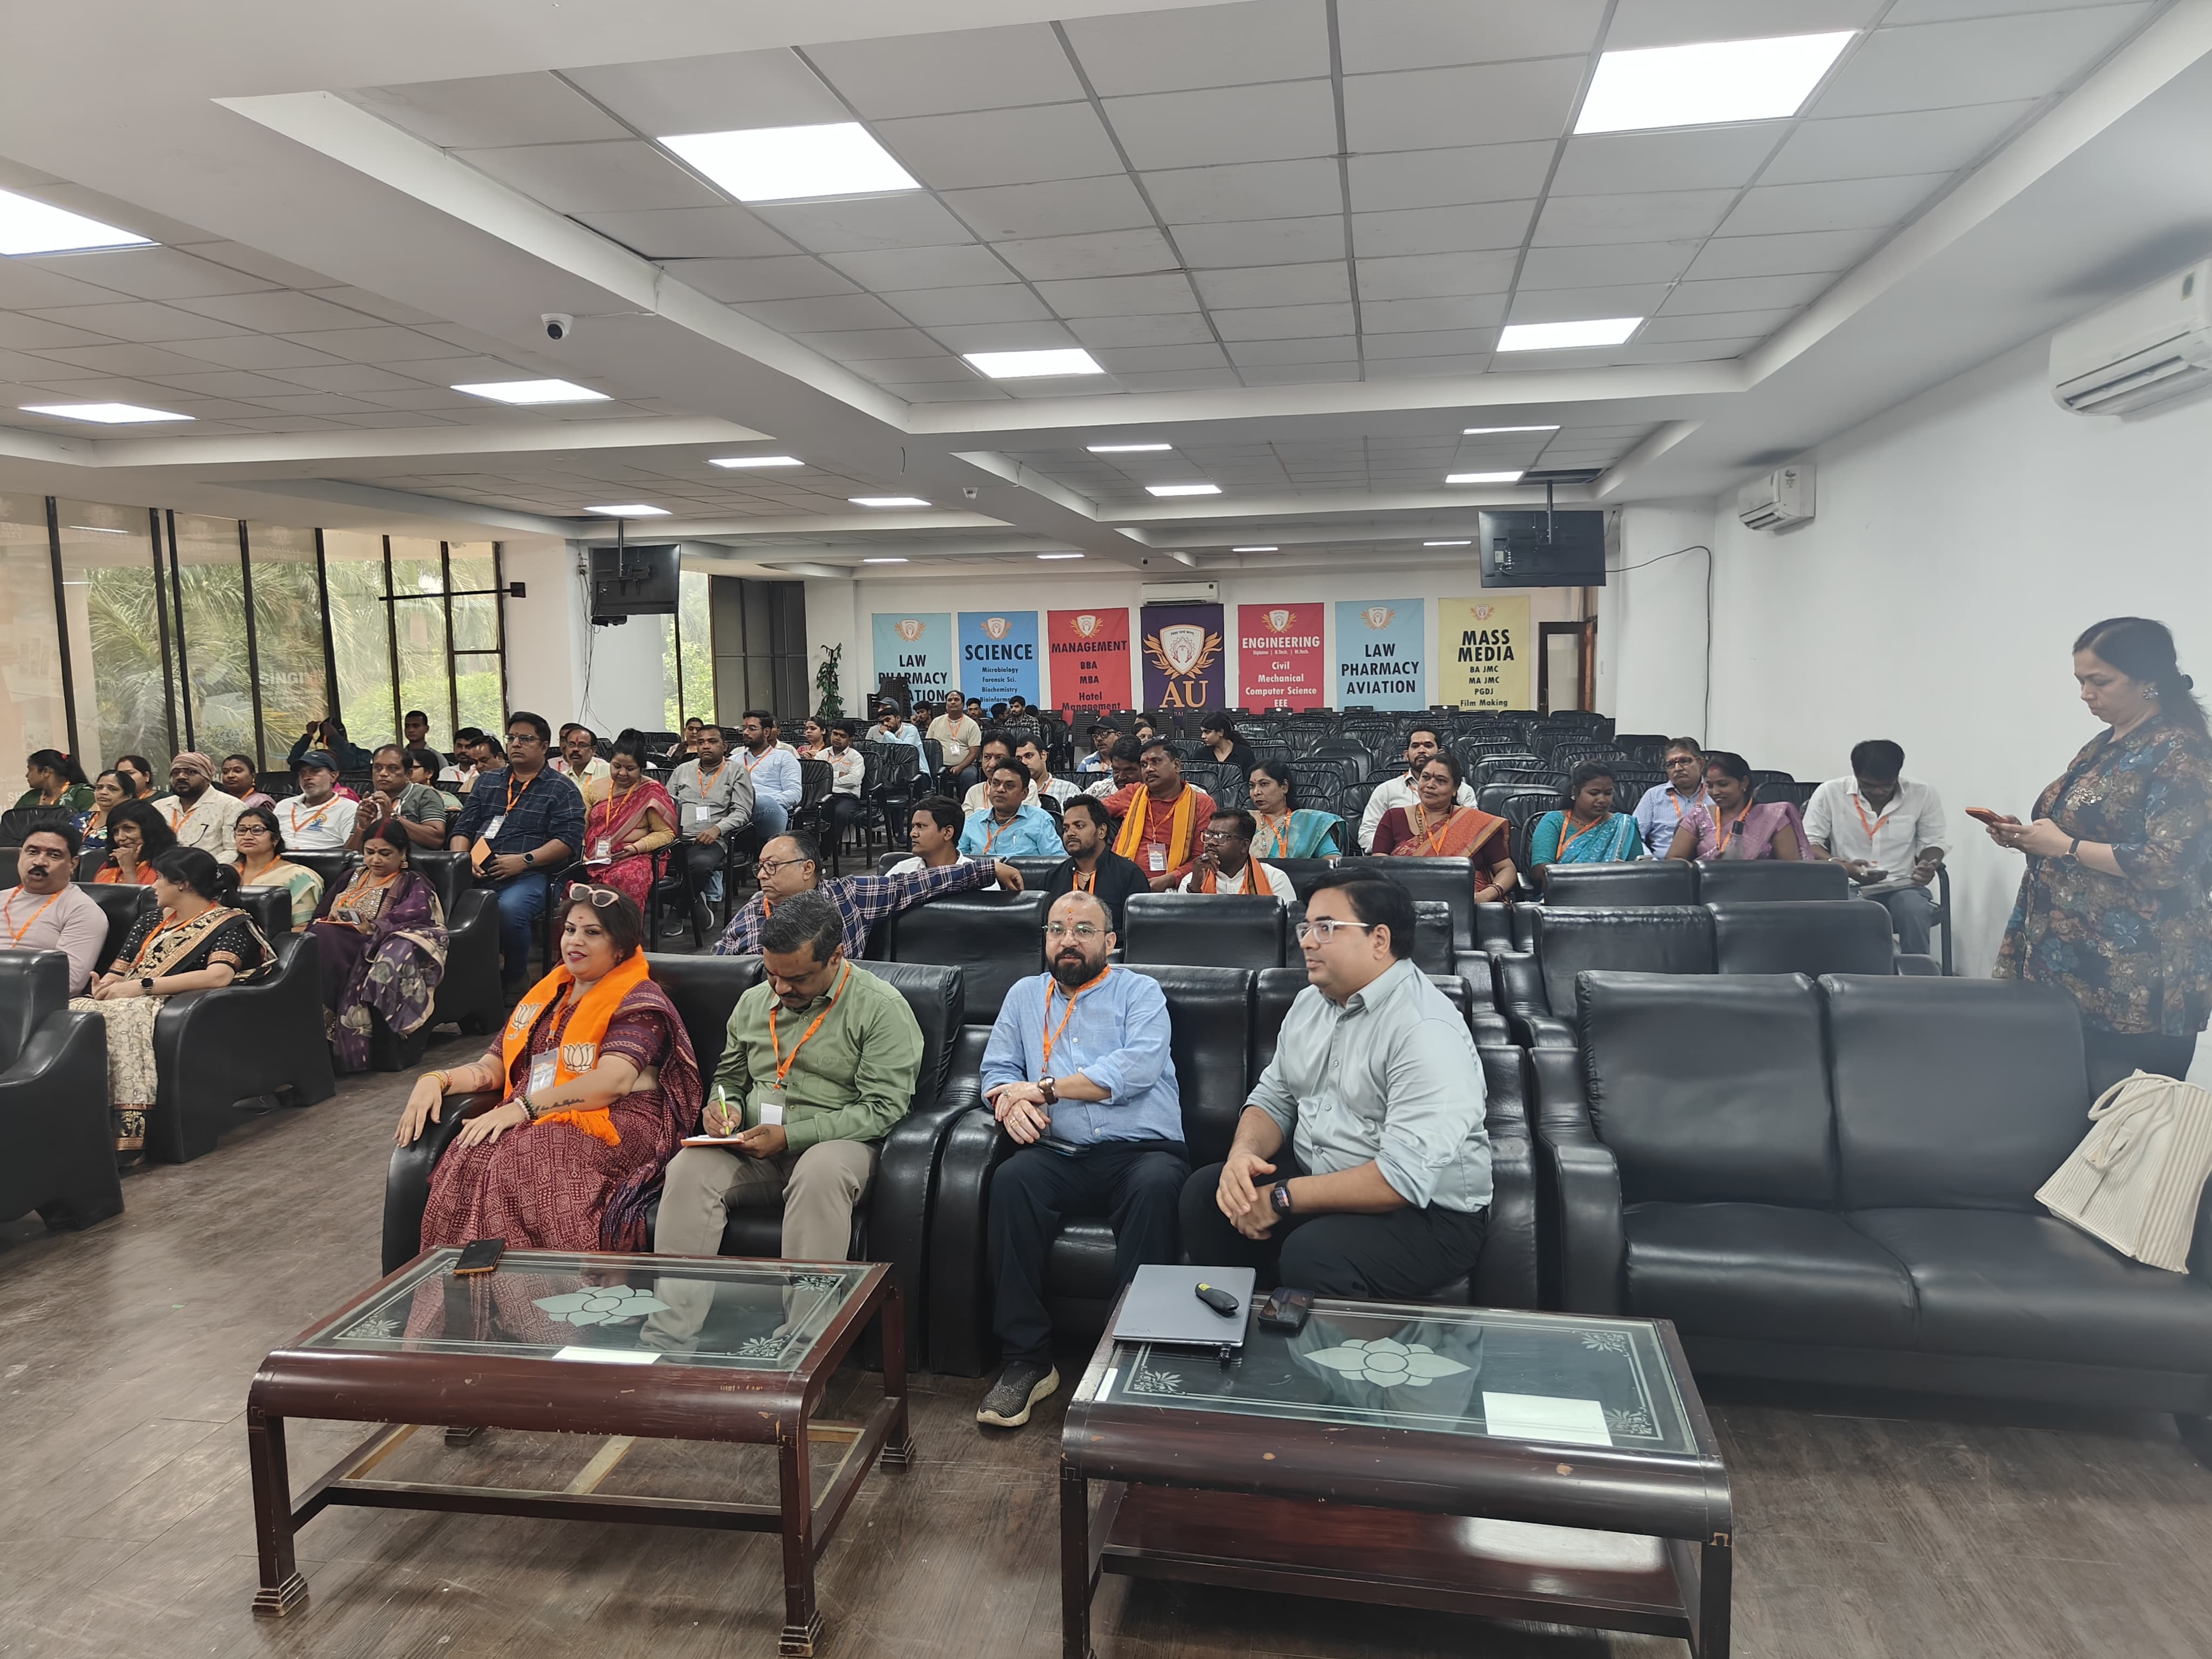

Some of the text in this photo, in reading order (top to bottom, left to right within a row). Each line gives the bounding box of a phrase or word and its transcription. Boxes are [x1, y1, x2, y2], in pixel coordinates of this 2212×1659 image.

[1243, 637, 1320, 649] ENGINEERING
[1462, 630, 1509, 645] MASS
[966, 644, 1033, 660] SCIENCE
[1052, 640, 1128, 653] MANAGEMENT
[1365, 644, 1395, 657] LAW
[1458, 646, 1514, 662] MEDIA
[900, 655, 926, 667] LAW
[1081, 662, 1097, 670] BBA
[1272, 661, 1290, 670] Civil
[1341, 662, 1419, 676] PHARMACY
[1080, 676, 1100, 684] MBA
[1258, 674, 1304, 683] Mechanical
[1245, 686, 1317, 697] Computer Science
[1346, 680, 1415, 694] AVIATION
[1079, 692, 1102, 700] Hotel
[1159, 680, 1209, 708] AU
[1274, 699, 1288, 707] EEE
[1479, 699, 1508, 707] Making
